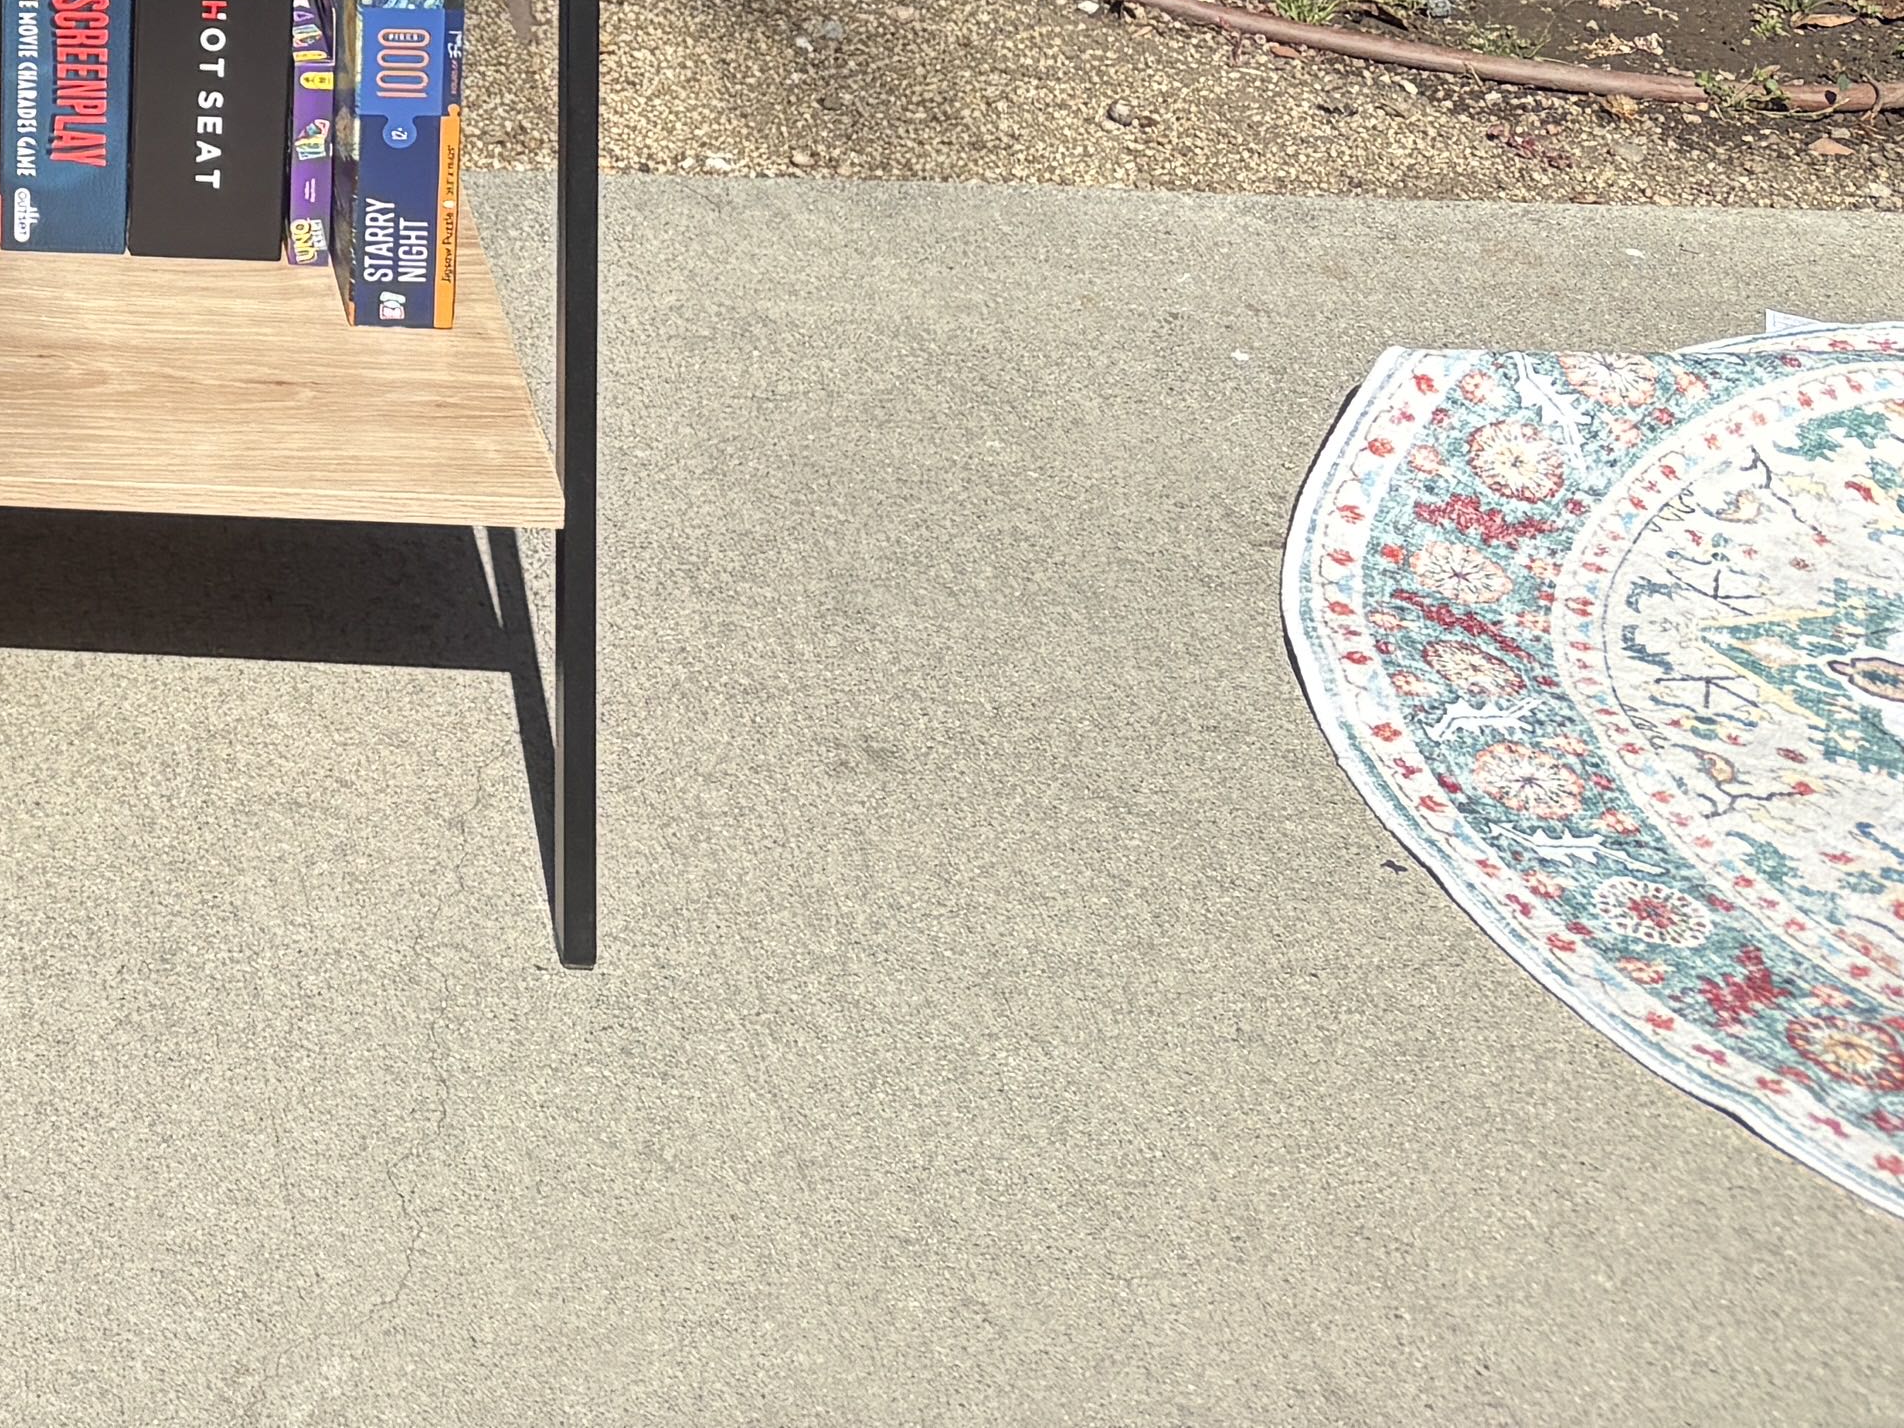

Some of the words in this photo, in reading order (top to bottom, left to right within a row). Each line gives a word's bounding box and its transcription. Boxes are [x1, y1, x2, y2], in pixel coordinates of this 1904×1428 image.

[18, 12, 39, 58] MOVIE
[198, 0, 229, 78] HOT
[376, 27, 431, 99] 1000
[17, 61, 38, 134] CHARADES
[16, 136, 37, 177] GAME
[194, 90, 225, 190] SEAT
[290, 219, 318, 263] UNO
[364, 197, 395, 282] STARRY
[399, 216, 428, 282] NIGHT
[442, 212, 454, 246] Puzzle
[440, 247, 453, 284] Jigsaw
